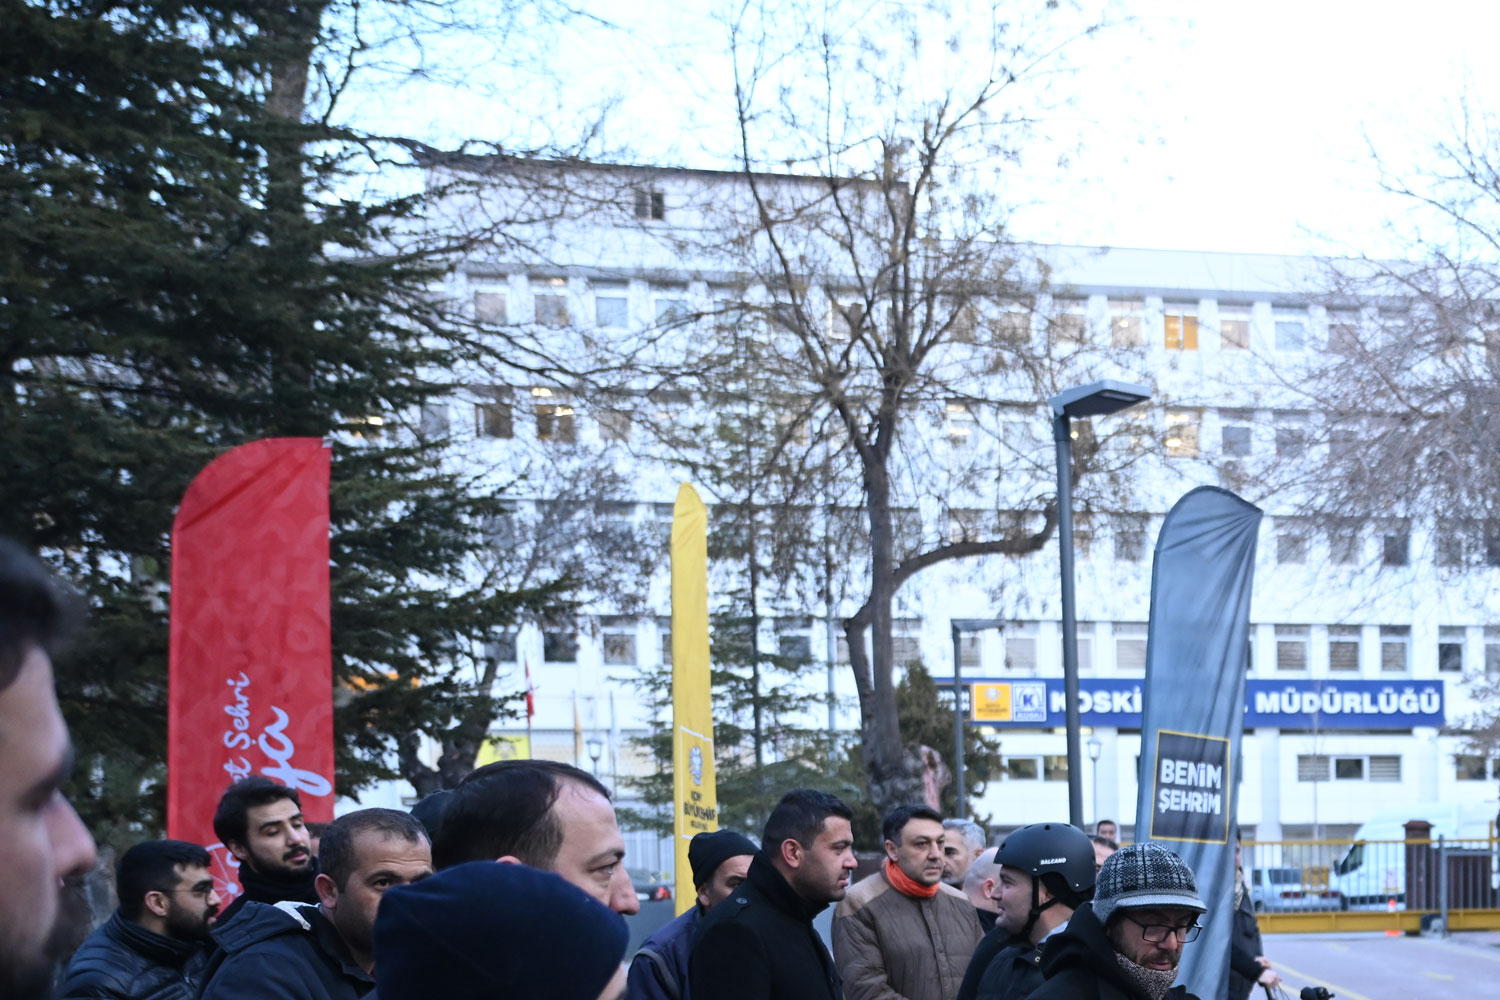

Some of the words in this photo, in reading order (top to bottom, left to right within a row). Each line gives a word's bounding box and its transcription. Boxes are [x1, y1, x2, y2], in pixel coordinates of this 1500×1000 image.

[224, 671, 257, 750] Şehri
[1255, 686, 1440, 714] MÜDÜRLÜĞÜ
[1161, 758, 1222, 789] BENİM
[1159, 788, 1221, 815] ŞEHRİM
